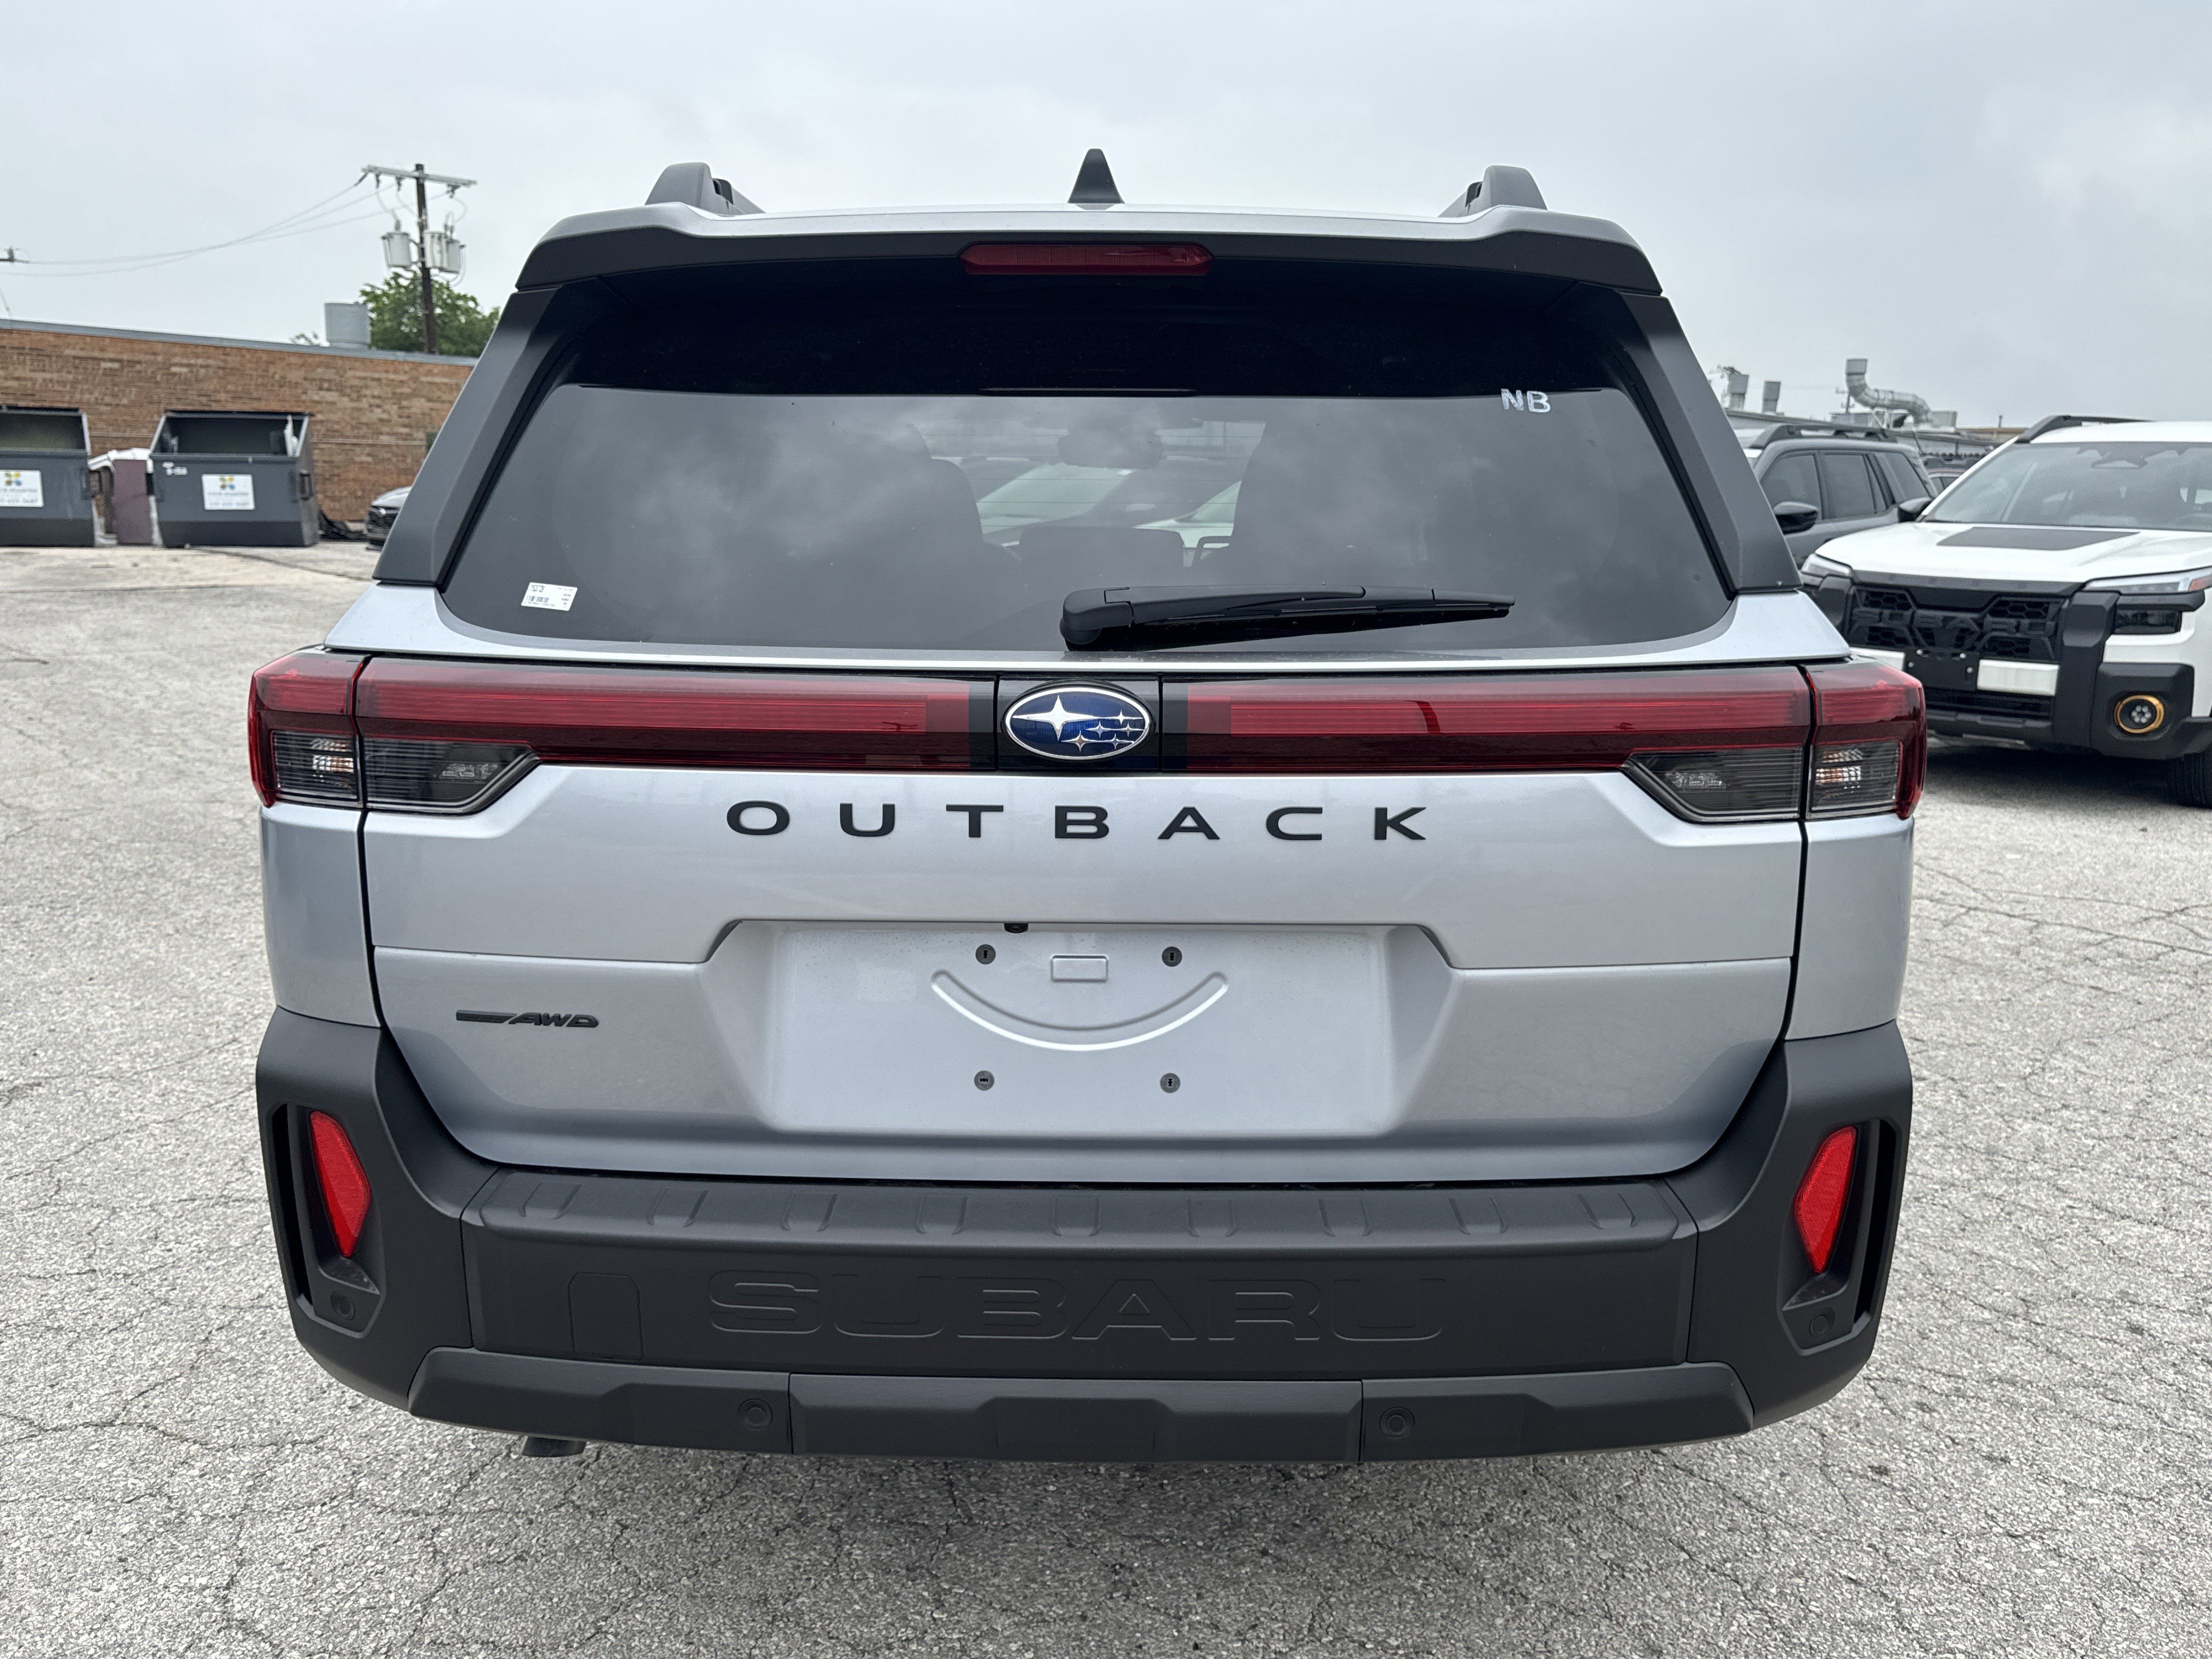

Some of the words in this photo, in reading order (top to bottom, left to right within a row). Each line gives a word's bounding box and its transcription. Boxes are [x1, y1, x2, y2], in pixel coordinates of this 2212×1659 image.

[1500, 388, 1551, 413] NB
[726, 800, 1427, 841] OUTBACK
[508, 1012, 599, 1028] AWD
[708, 1269, 1447, 1342] SUBARU
